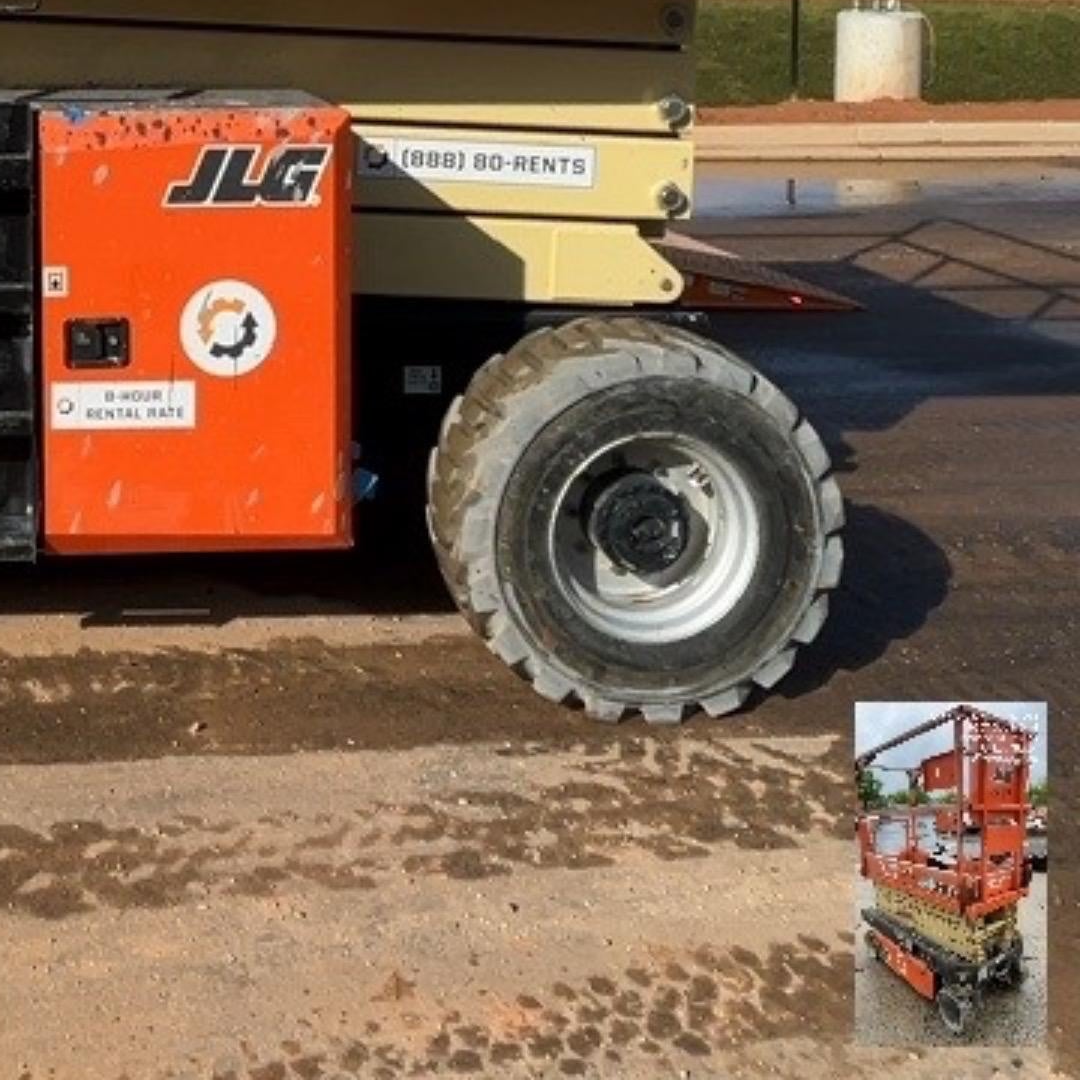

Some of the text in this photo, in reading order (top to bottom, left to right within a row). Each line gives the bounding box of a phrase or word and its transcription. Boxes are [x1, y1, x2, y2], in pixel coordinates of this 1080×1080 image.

[401, 149, 586, 175] (888) 80-RENTS
[161, 143, 333, 209] JLG
[86, 406, 185, 420] RENTAL RATE
